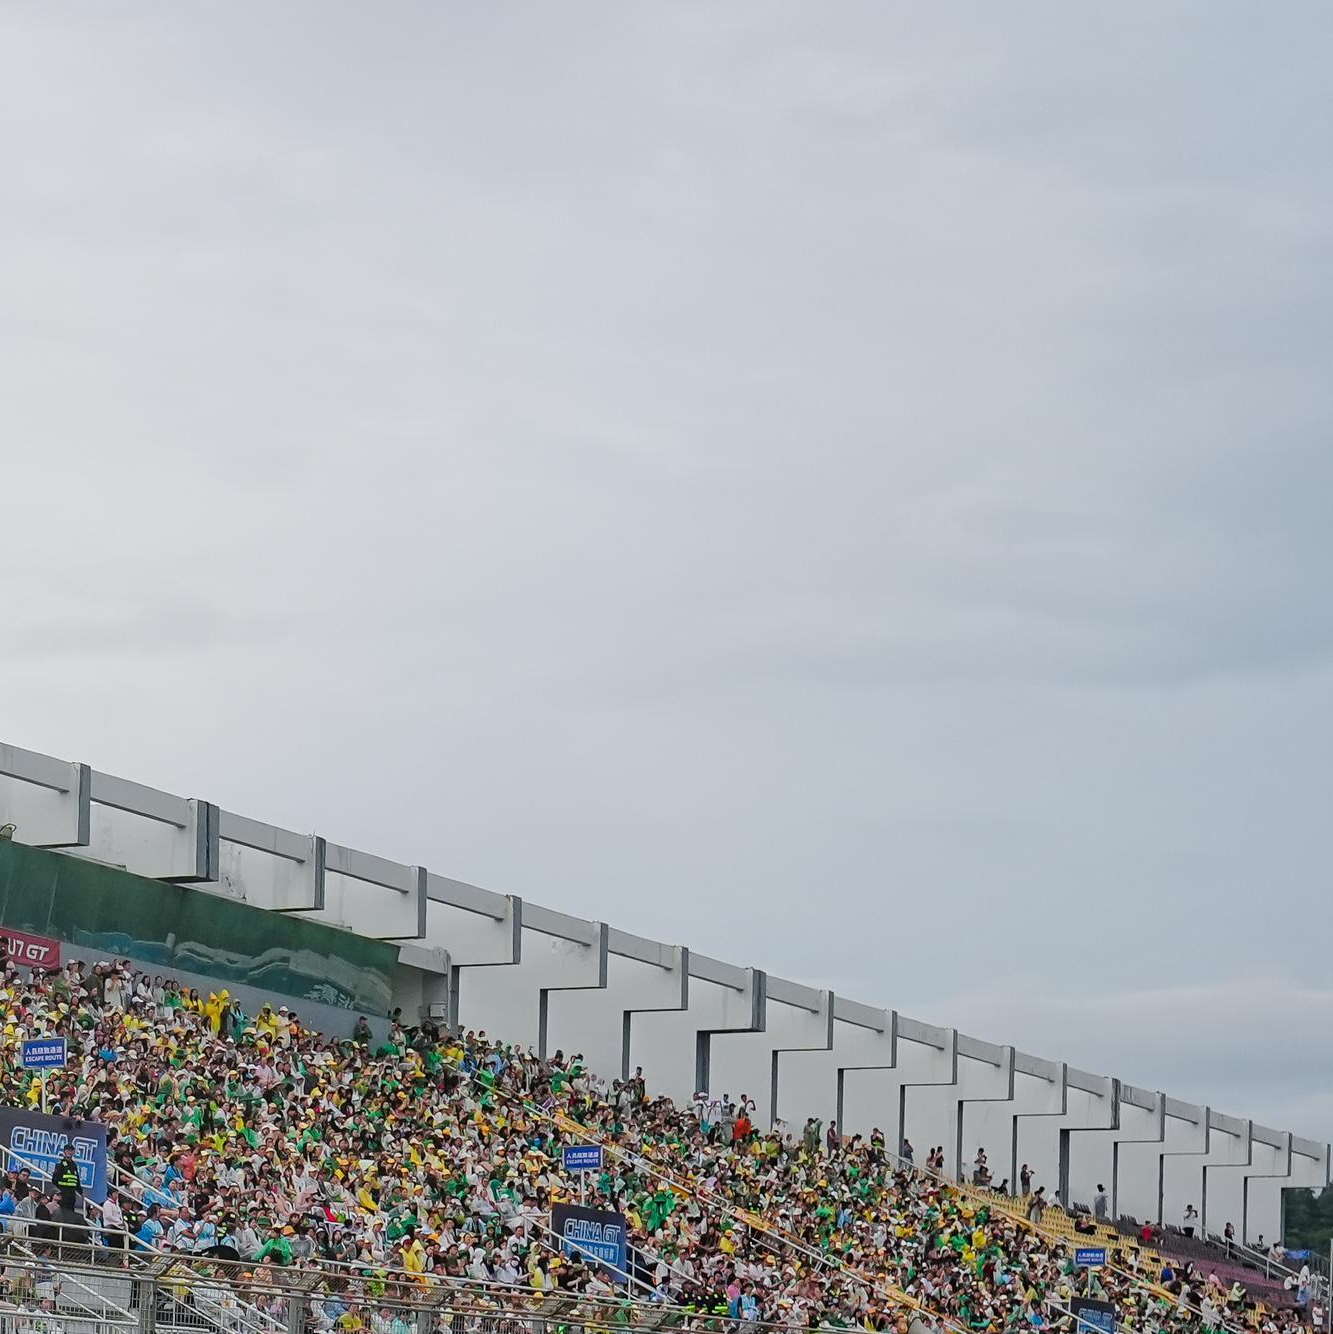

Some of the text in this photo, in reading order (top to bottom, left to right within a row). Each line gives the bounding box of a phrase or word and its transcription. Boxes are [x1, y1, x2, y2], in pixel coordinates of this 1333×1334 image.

[26, 944, 49, 960] GT
[10, 1126, 68, 1158] CHINA
[564, 1218, 602, 1243] CHINA
